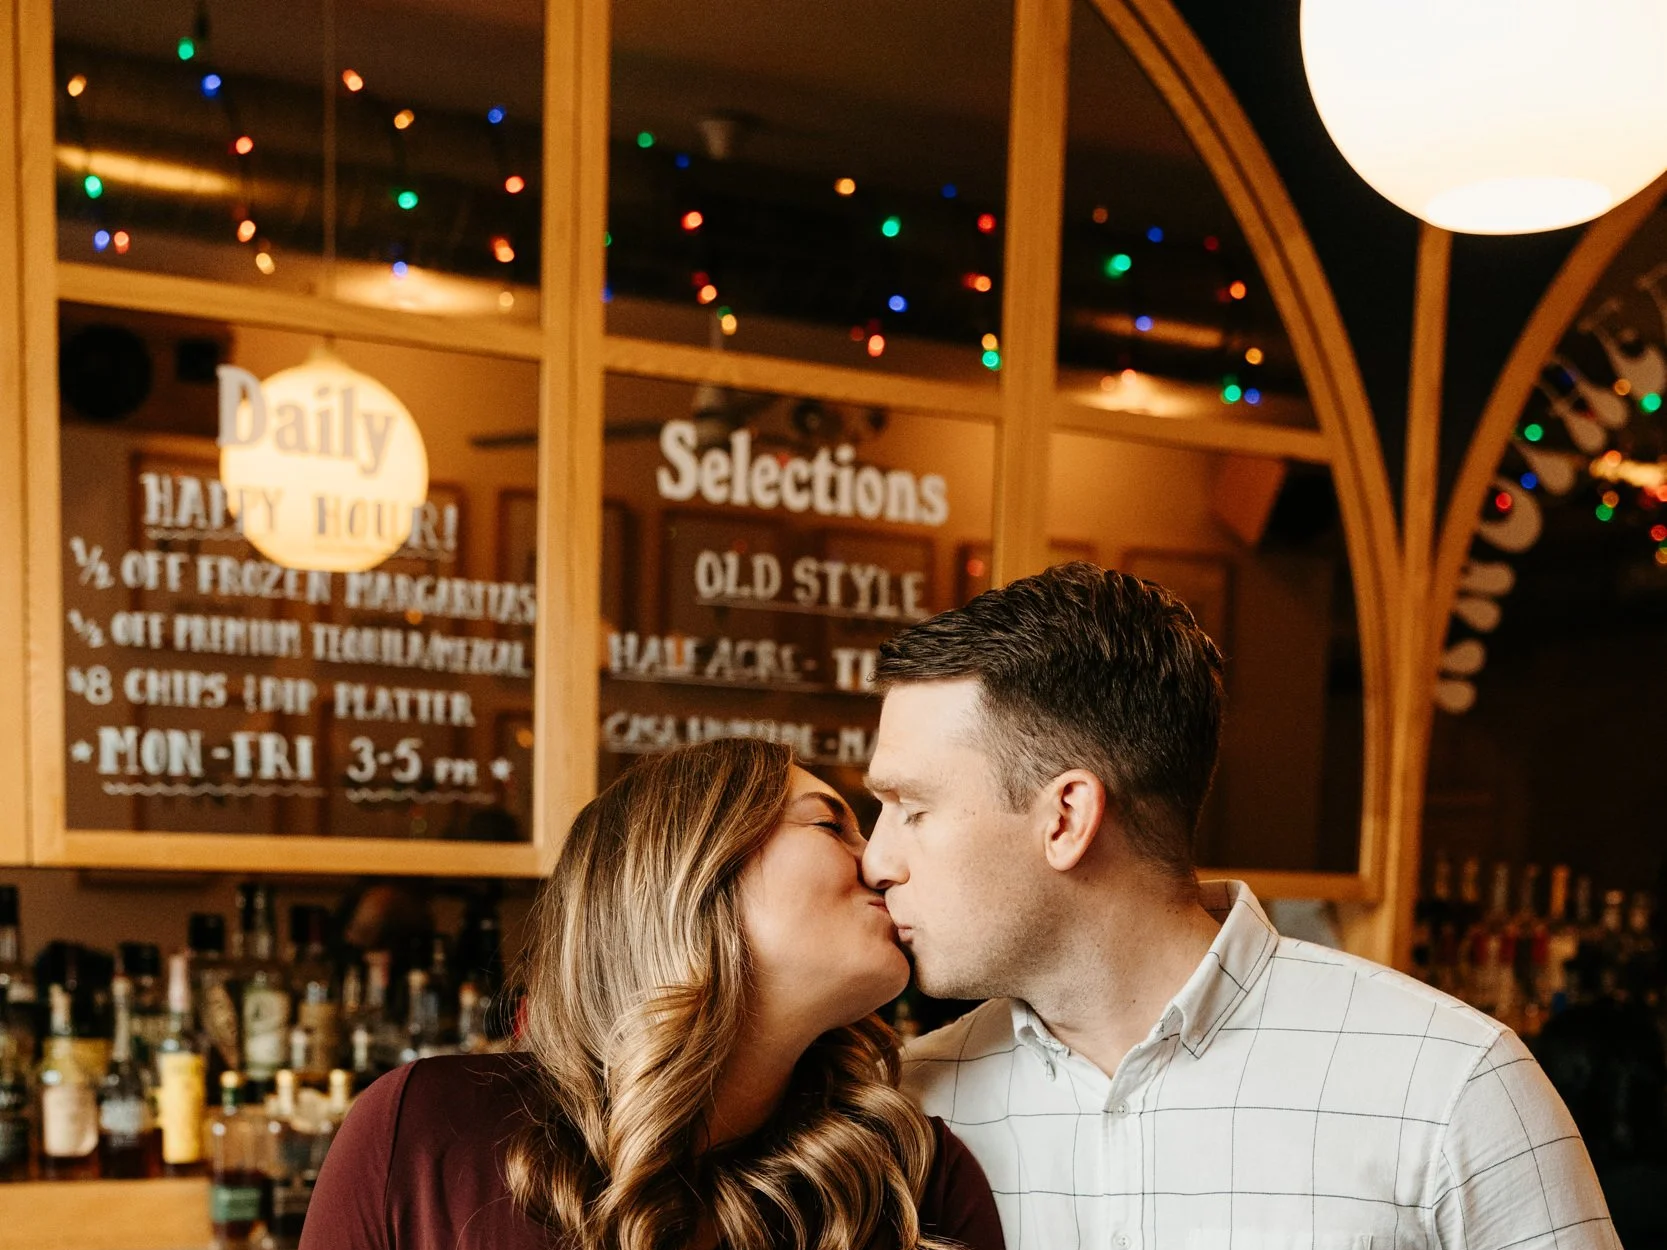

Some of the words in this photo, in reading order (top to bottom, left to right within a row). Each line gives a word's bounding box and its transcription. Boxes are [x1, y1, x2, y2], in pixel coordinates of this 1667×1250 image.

[217, 364, 394, 473] Daily
[656, 419, 948, 527] Selections
[120, 550, 189, 592] OFF
[197, 555, 332, 604] FROZEN
[695, 550, 782, 600] OLD
[792, 556, 930, 618] STYLE
[111, 611, 166, 649] OFF
[123, 667, 228, 708] CHIPS
[333, 681, 476, 728] PLATTER
[346, 736, 423, 784] 3-5
